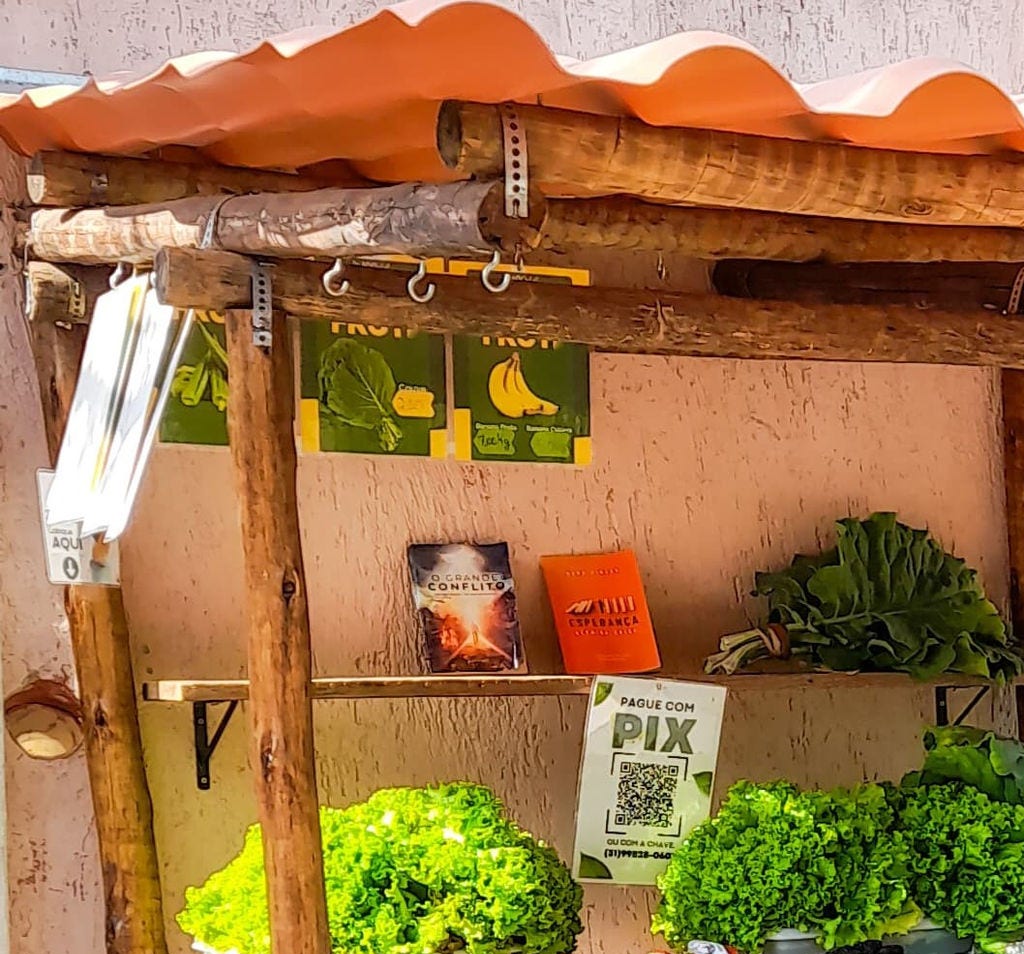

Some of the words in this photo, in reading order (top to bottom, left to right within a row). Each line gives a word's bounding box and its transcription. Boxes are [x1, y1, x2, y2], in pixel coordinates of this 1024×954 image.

[52, 536, 83, 551] AQUI
[431, 574, 440, 582] O
[427, 581, 505, 592] CONFLITO
[620, 696, 662, 710] PAGUE
[665, 701, 695, 713] COM
[612, 712, 698, 755] PIX
[606, 838, 619, 846] OU
[620, 839, 639, 847] COM
